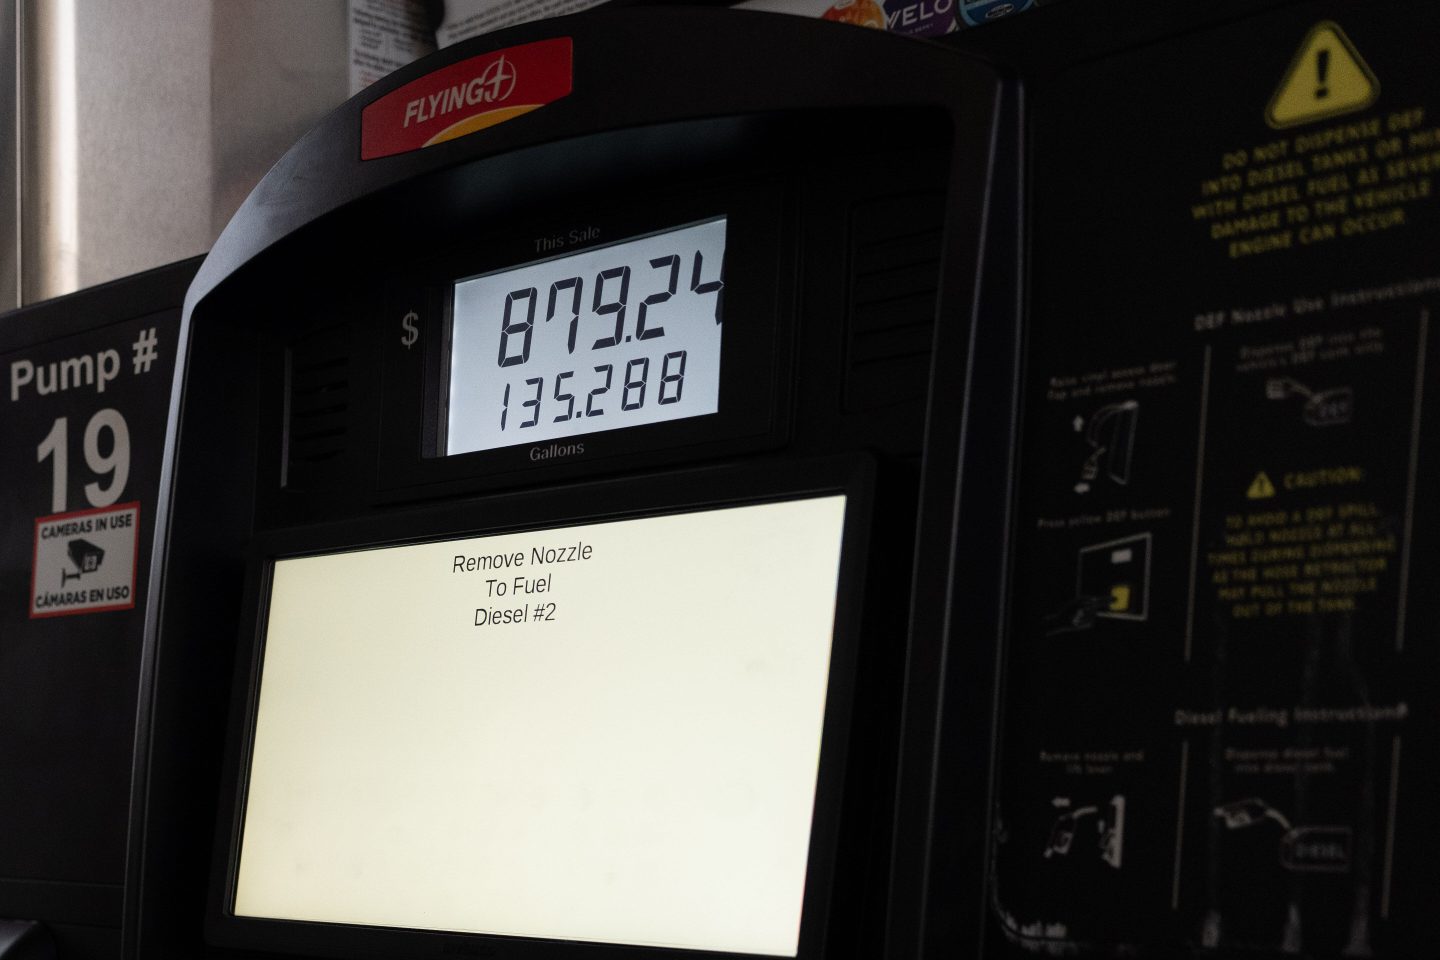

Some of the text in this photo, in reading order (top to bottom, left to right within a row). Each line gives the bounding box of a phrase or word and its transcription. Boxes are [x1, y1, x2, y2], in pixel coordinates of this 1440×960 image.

[534, 225, 601, 254] This Sale
[497, 250, 725, 368] 879.24
[401, 310, 419, 349] $
[10, 327, 159, 402] Pump #
[500, 350, 688, 432] 135.288
[36, 407, 131, 514] 19
[529, 442, 585, 462] Gallons
[41, 513, 133, 540] CAMERAS IN USE
[452, 541, 593, 574] Remove Nozzle
[35, 584, 130, 609] CÁMARAS EN USO
[485, 573, 552, 598] To Fuel
[474, 602, 557, 627] Diesel #2
